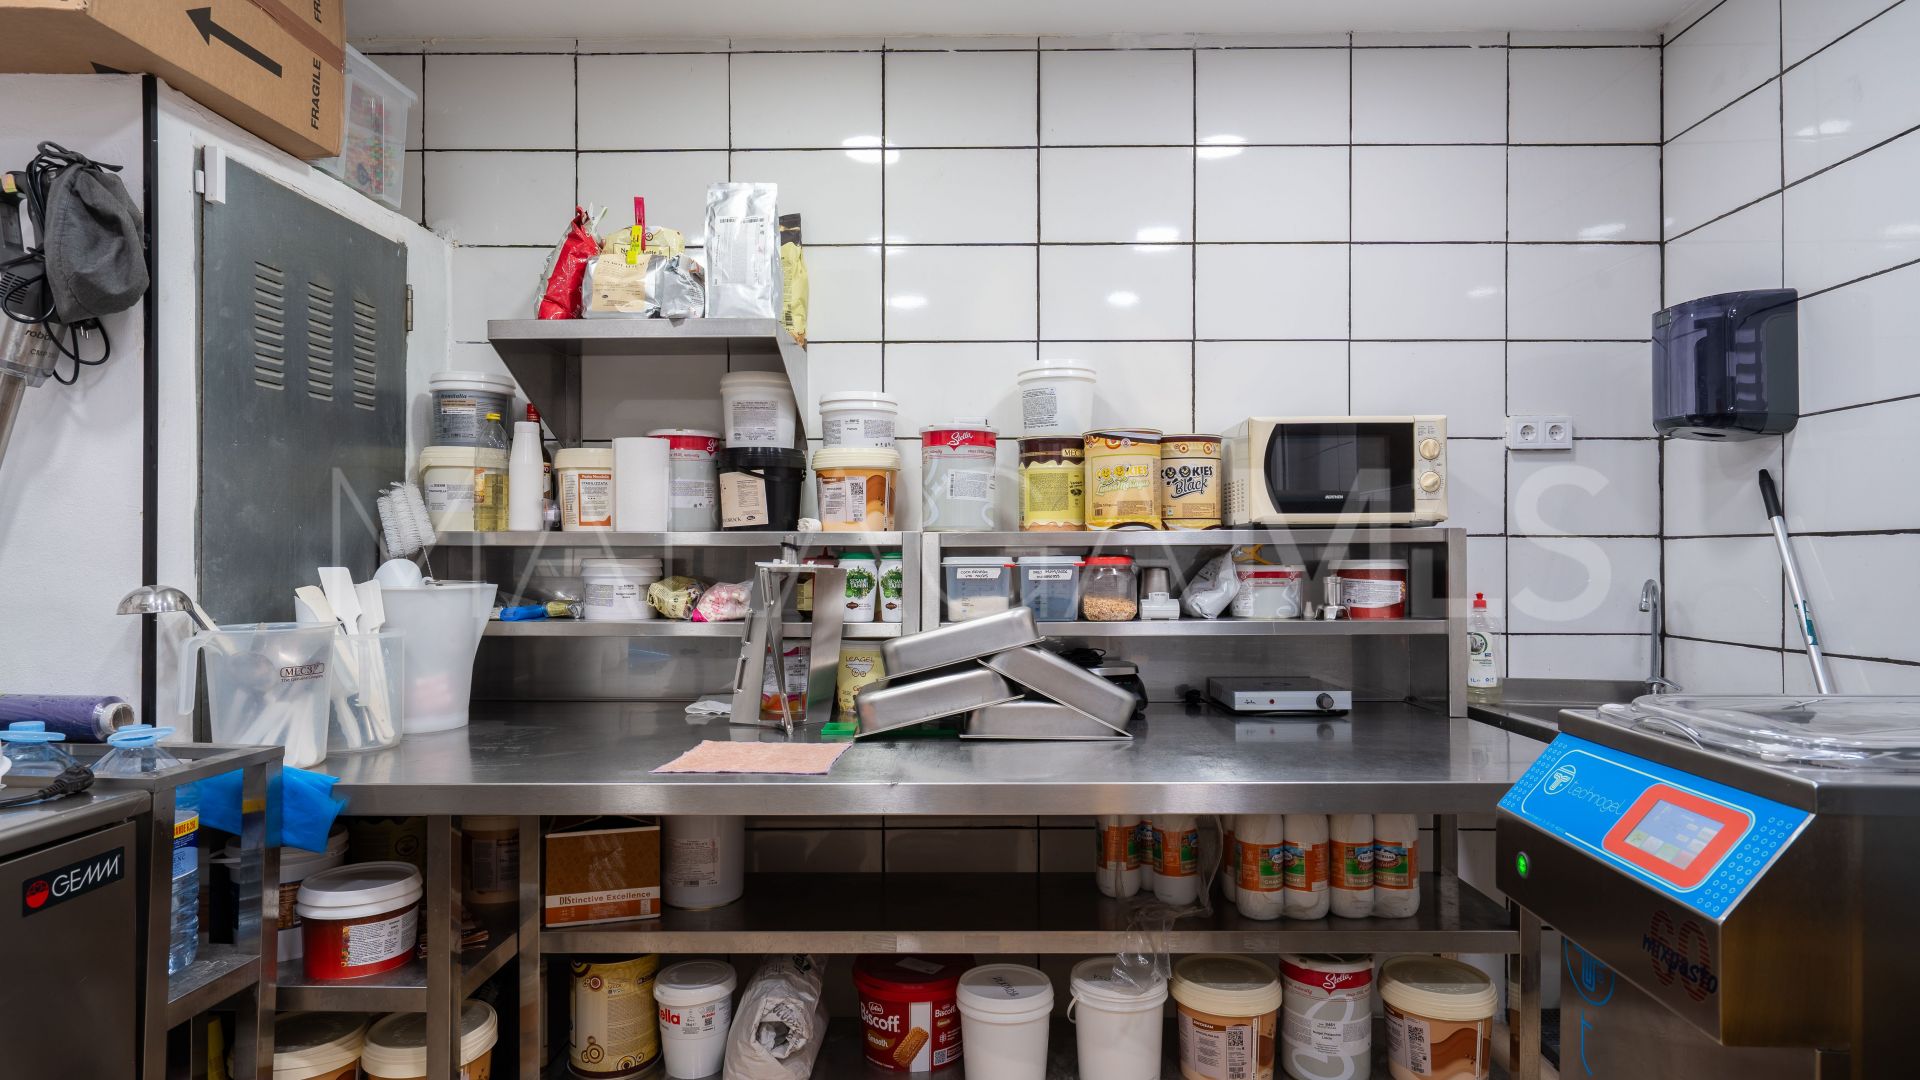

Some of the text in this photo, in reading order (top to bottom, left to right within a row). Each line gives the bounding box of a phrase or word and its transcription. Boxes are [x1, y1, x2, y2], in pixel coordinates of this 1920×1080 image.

[311, 0, 322, 23] FR
[310, 57, 322, 131] FRAGILE
[946, 431, 974, 447] Stella
[1173, 475, 1208, 496] Black
[845, 655, 873, 663] LEAGEL
[1567, 781, 1625, 815] technogel
[51, 854, 120, 898] GEMM
[559, 890, 651, 906] DIStinctive Excellence
[1650, 910, 1711, 1002] 60
[1322, 972, 1354, 990] Stella
[861, 1001, 901, 1033] Biscoff
[934, 1003, 957, 1018] Biscoff
[867, 1032, 889, 1048] Smooth
